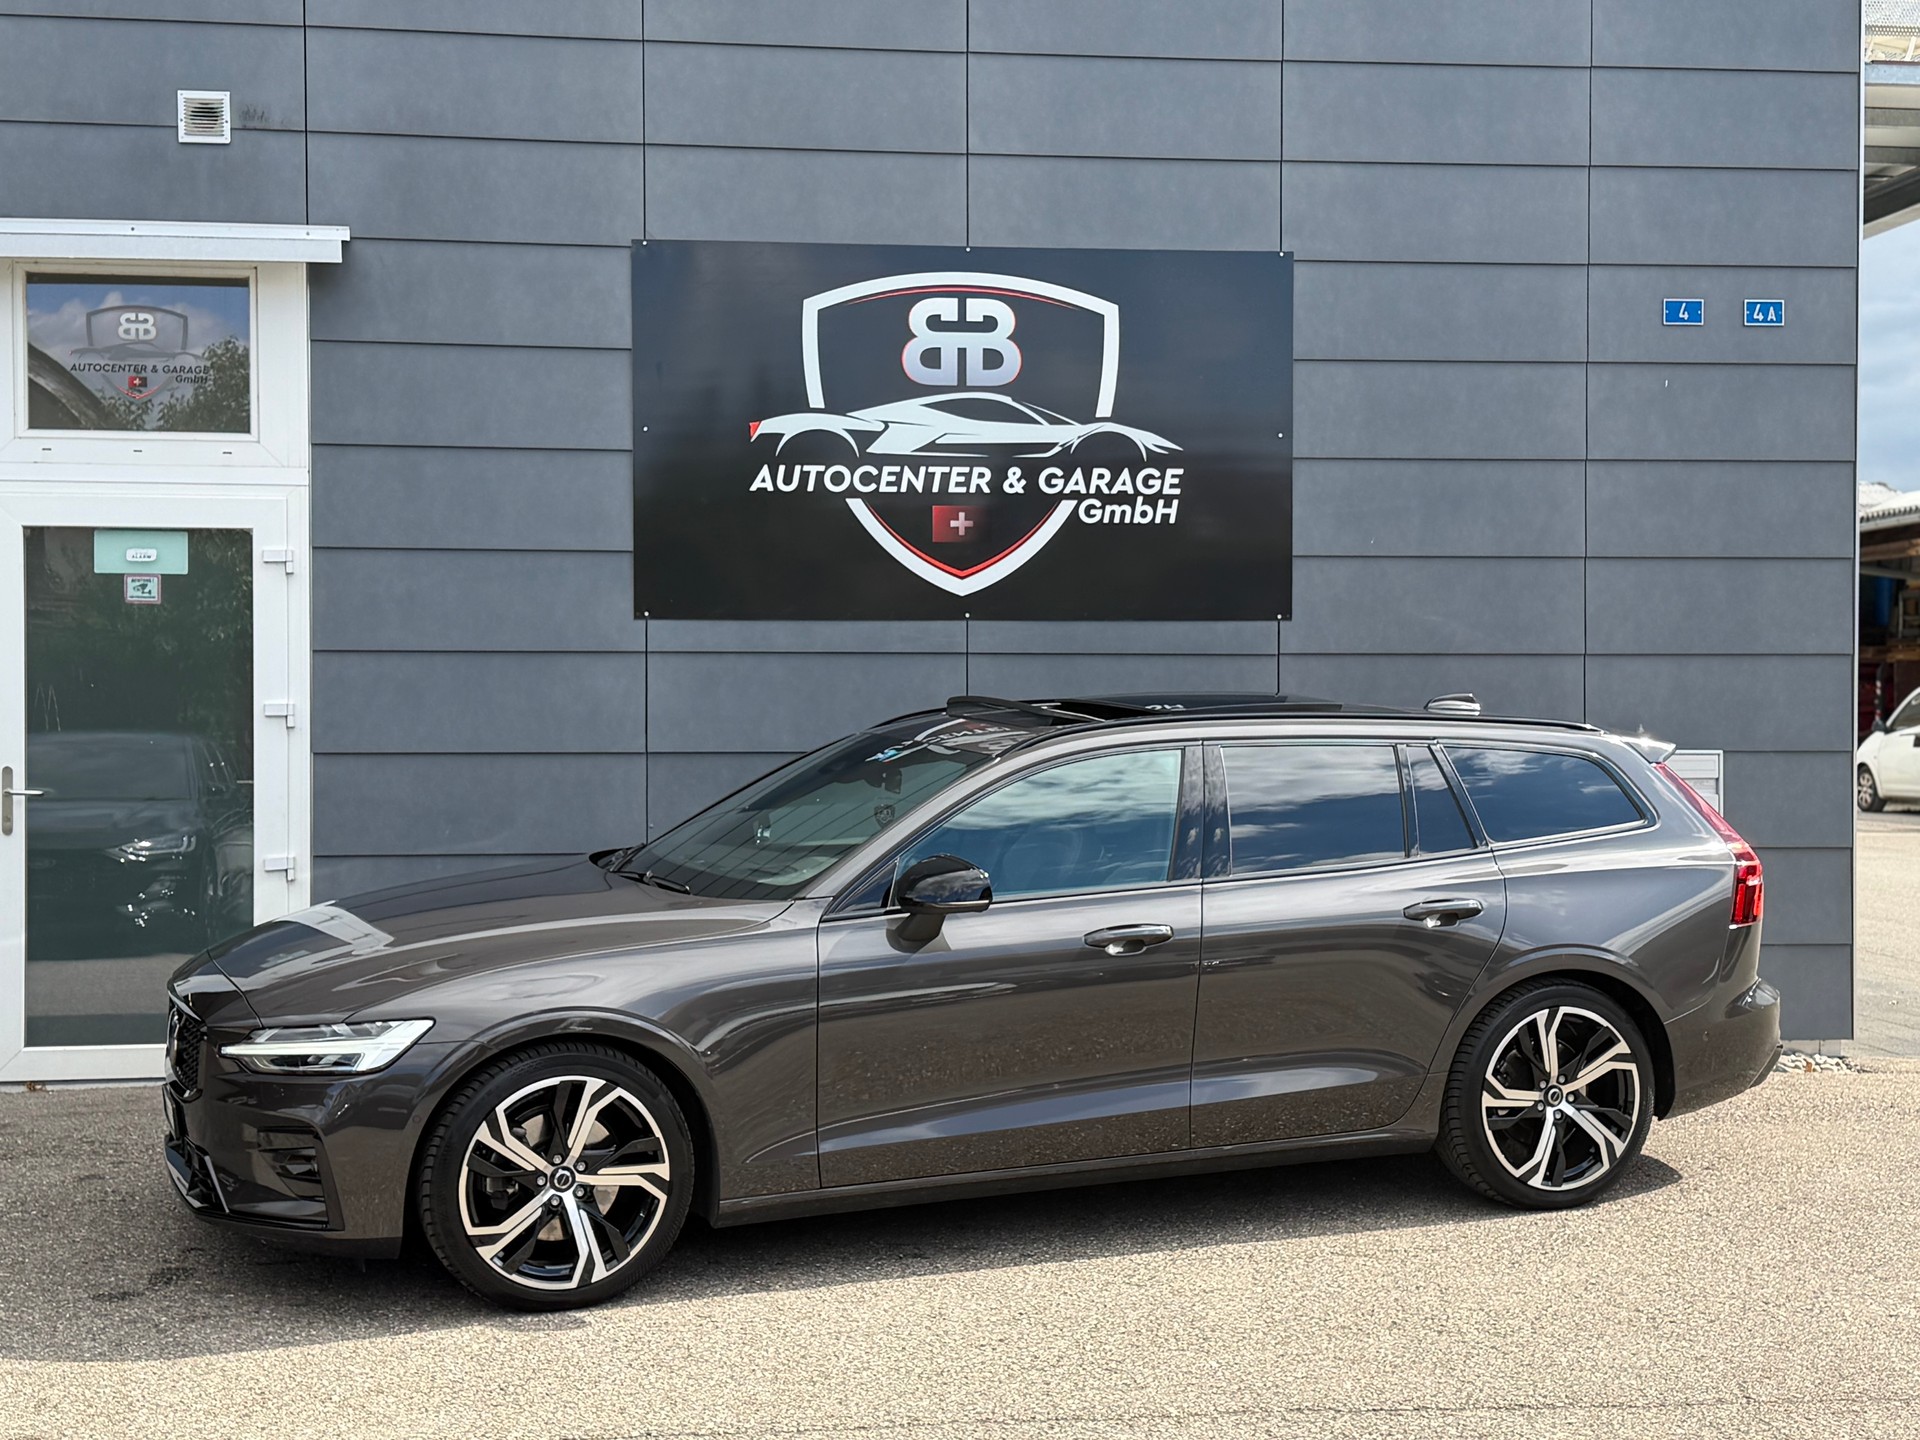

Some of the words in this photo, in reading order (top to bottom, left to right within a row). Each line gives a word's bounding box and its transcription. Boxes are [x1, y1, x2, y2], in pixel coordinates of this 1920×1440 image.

[1679, 302, 1689, 320] 4
[70, 362, 147, 374] AUTOCENTER
[150, 364, 159, 374] &
[162, 364, 210, 375] GARAGE
[175, 374, 209, 385] GmbH
[749, 463, 992, 494] AUTOCENTER
[1002, 466, 1027, 495] &
[1038, 466, 1185, 496] GARAGE
[1077, 495, 1179, 525] GmbH
